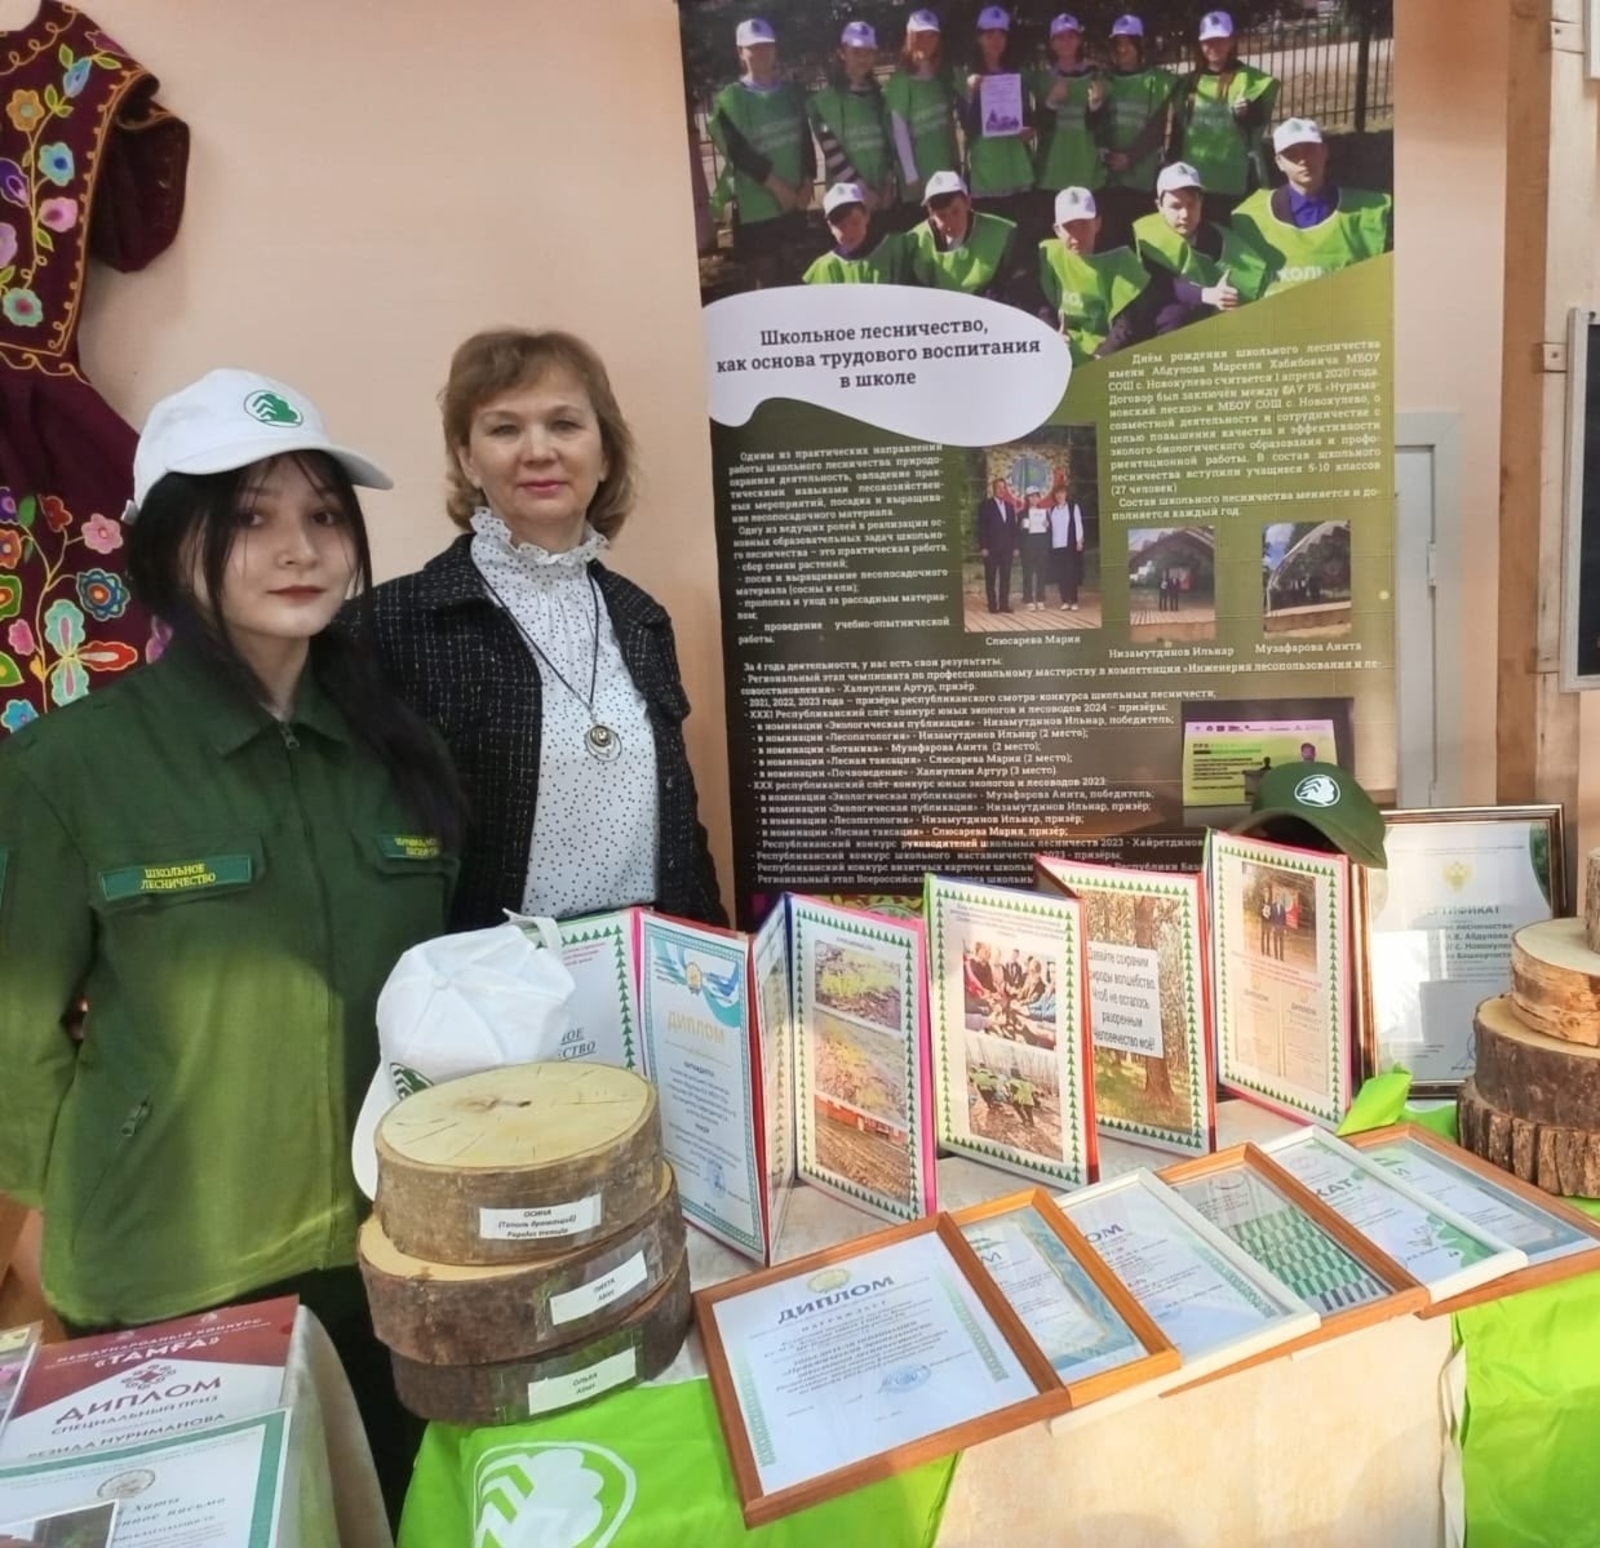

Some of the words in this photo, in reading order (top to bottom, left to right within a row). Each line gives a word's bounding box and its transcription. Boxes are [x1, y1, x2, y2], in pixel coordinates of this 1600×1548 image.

[761, 324, 855, 344] Школьное
[860, 318, 988, 341] лесничество,
[717, 357, 746, 371] как
[751, 353, 815, 369] основа
[820, 347, 917, 368] трудового
[922, 340, 1040, 359] воспитания
[840, 375, 850, 387] в
[855, 372, 916, 386] школе
[986, 634, 1042, 647] Слюсарева
[1044, 633, 1080, 645] Мария
[1255, 641, 1323, 654] Музафарова
[1326, 640, 1361, 651] Анита
[1109, 646, 1189, 659] Низамутдинов
[1192, 645, 1234, 658] Ильнар
[141, 873, 216, 889] ЛЕСНИЧЕСТВО
[145, 863, 206, 878] ШКОЛЬНОЕ
[667, 1011, 725, 1044] ДИПЛОМ
[778, 1275, 895, 1325] ДИПЛОМ
[55, 1376, 221, 1425] ДИПЛОМ
[51, 1402, 176, 1435] СПЕЦИАЛЬНЫЙ
[178, 1393, 219, 1410] ПРИЗ
